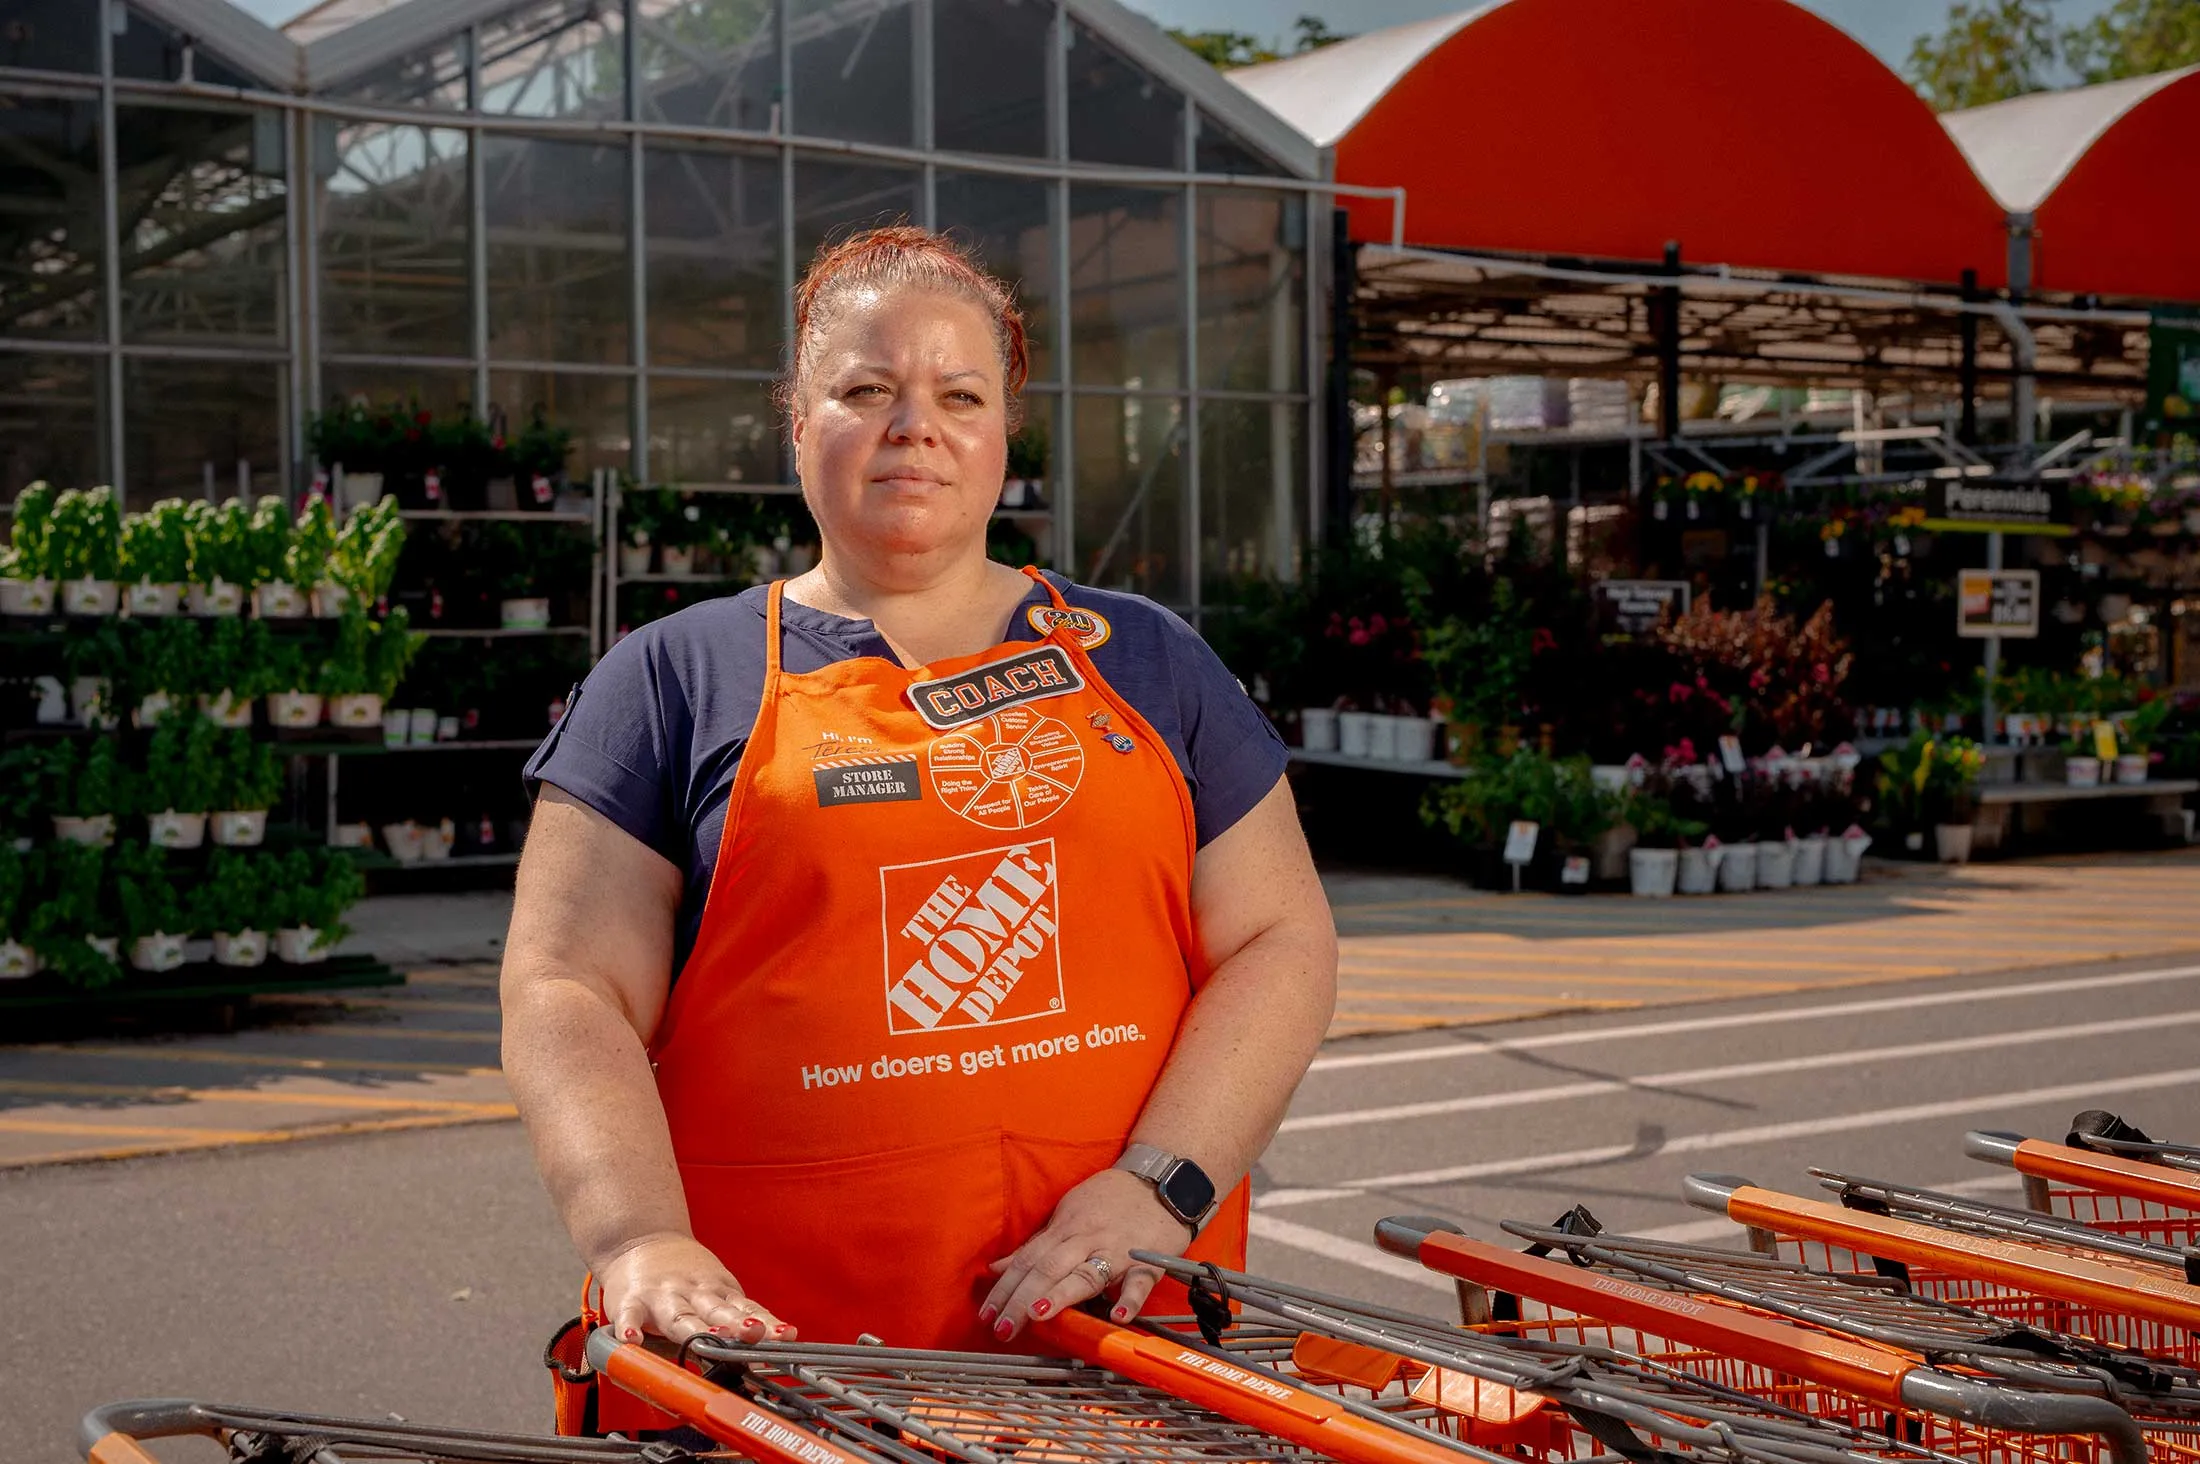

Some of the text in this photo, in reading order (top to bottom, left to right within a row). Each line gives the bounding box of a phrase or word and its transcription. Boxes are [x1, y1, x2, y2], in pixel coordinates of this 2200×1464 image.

[927, 658, 1068, 718] COACH
[822, 731, 872, 744] Hi, I'm
[842, 769, 893, 784] STORE
[942, 780, 961, 788] Doing
[832, 781, 907, 798] MANAGER
[941, 786, 958, 795] Right
[1027, 784, 1050, 792] Taking
[1028, 791, 1044, 799] Care
[974, 798, 1011, 811] Respect for
[1024, 794, 1060, 808] Our People
[978, 805, 1011, 816] All People
[900, 874, 973, 946] THE
[887, 845, 1056, 1029] HOME
[958, 903, 1058, 1025] DEPOT
[801, 1064, 863, 1090] How
[871, 1054, 952, 1080] doers
[959, 1044, 1006, 1076] get
[1012, 1032, 1080, 1064] more
[1592, 1278, 1705, 1315] THE HOME DEPOT
[1176, 1351, 1294, 1400] THE HOME DEPOT
[740, 1411, 772, 1435] THE
[764, 1424, 806, 1452] HOME
